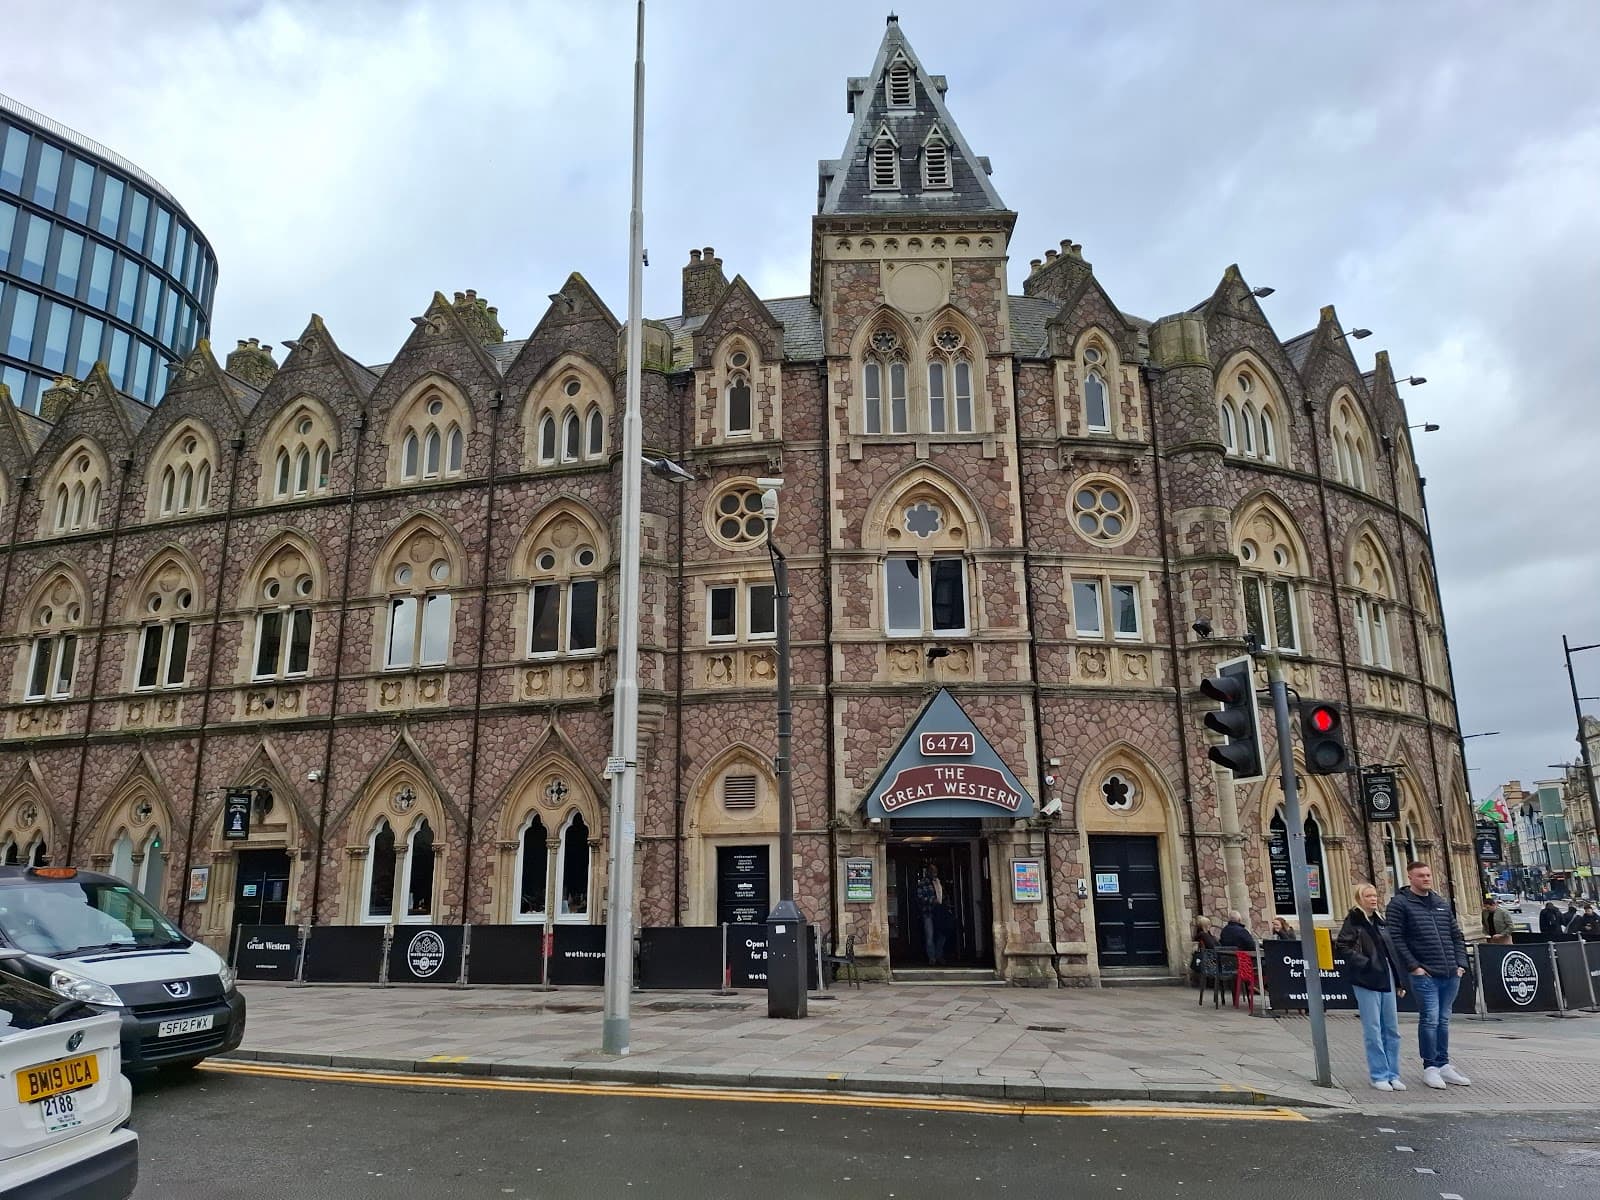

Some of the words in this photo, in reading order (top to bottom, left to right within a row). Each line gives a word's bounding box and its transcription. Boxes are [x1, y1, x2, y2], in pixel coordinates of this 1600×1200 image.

[926, 737, 969, 750] 6474
[934, 768, 965, 780] THE
[885, 783, 934, 807] GREAT
[944, 782, 1018, 807] WESTERN
[247, 941, 264, 950] Great
[266, 942, 290, 950] Western
[745, 939, 765, 950] Open
[564, 951, 606, 959] wetherspo
[751, 951, 761, 959] for
[1290, 969, 1302, 977] for
[166, 1021, 188, 1034] SF12
[190, 1017, 208, 1030] FWX
[28, 1067, 63, 1096] BM19
[65, 1060, 92, 1085] UCA
[44, 1095, 74, 1117] 2188
